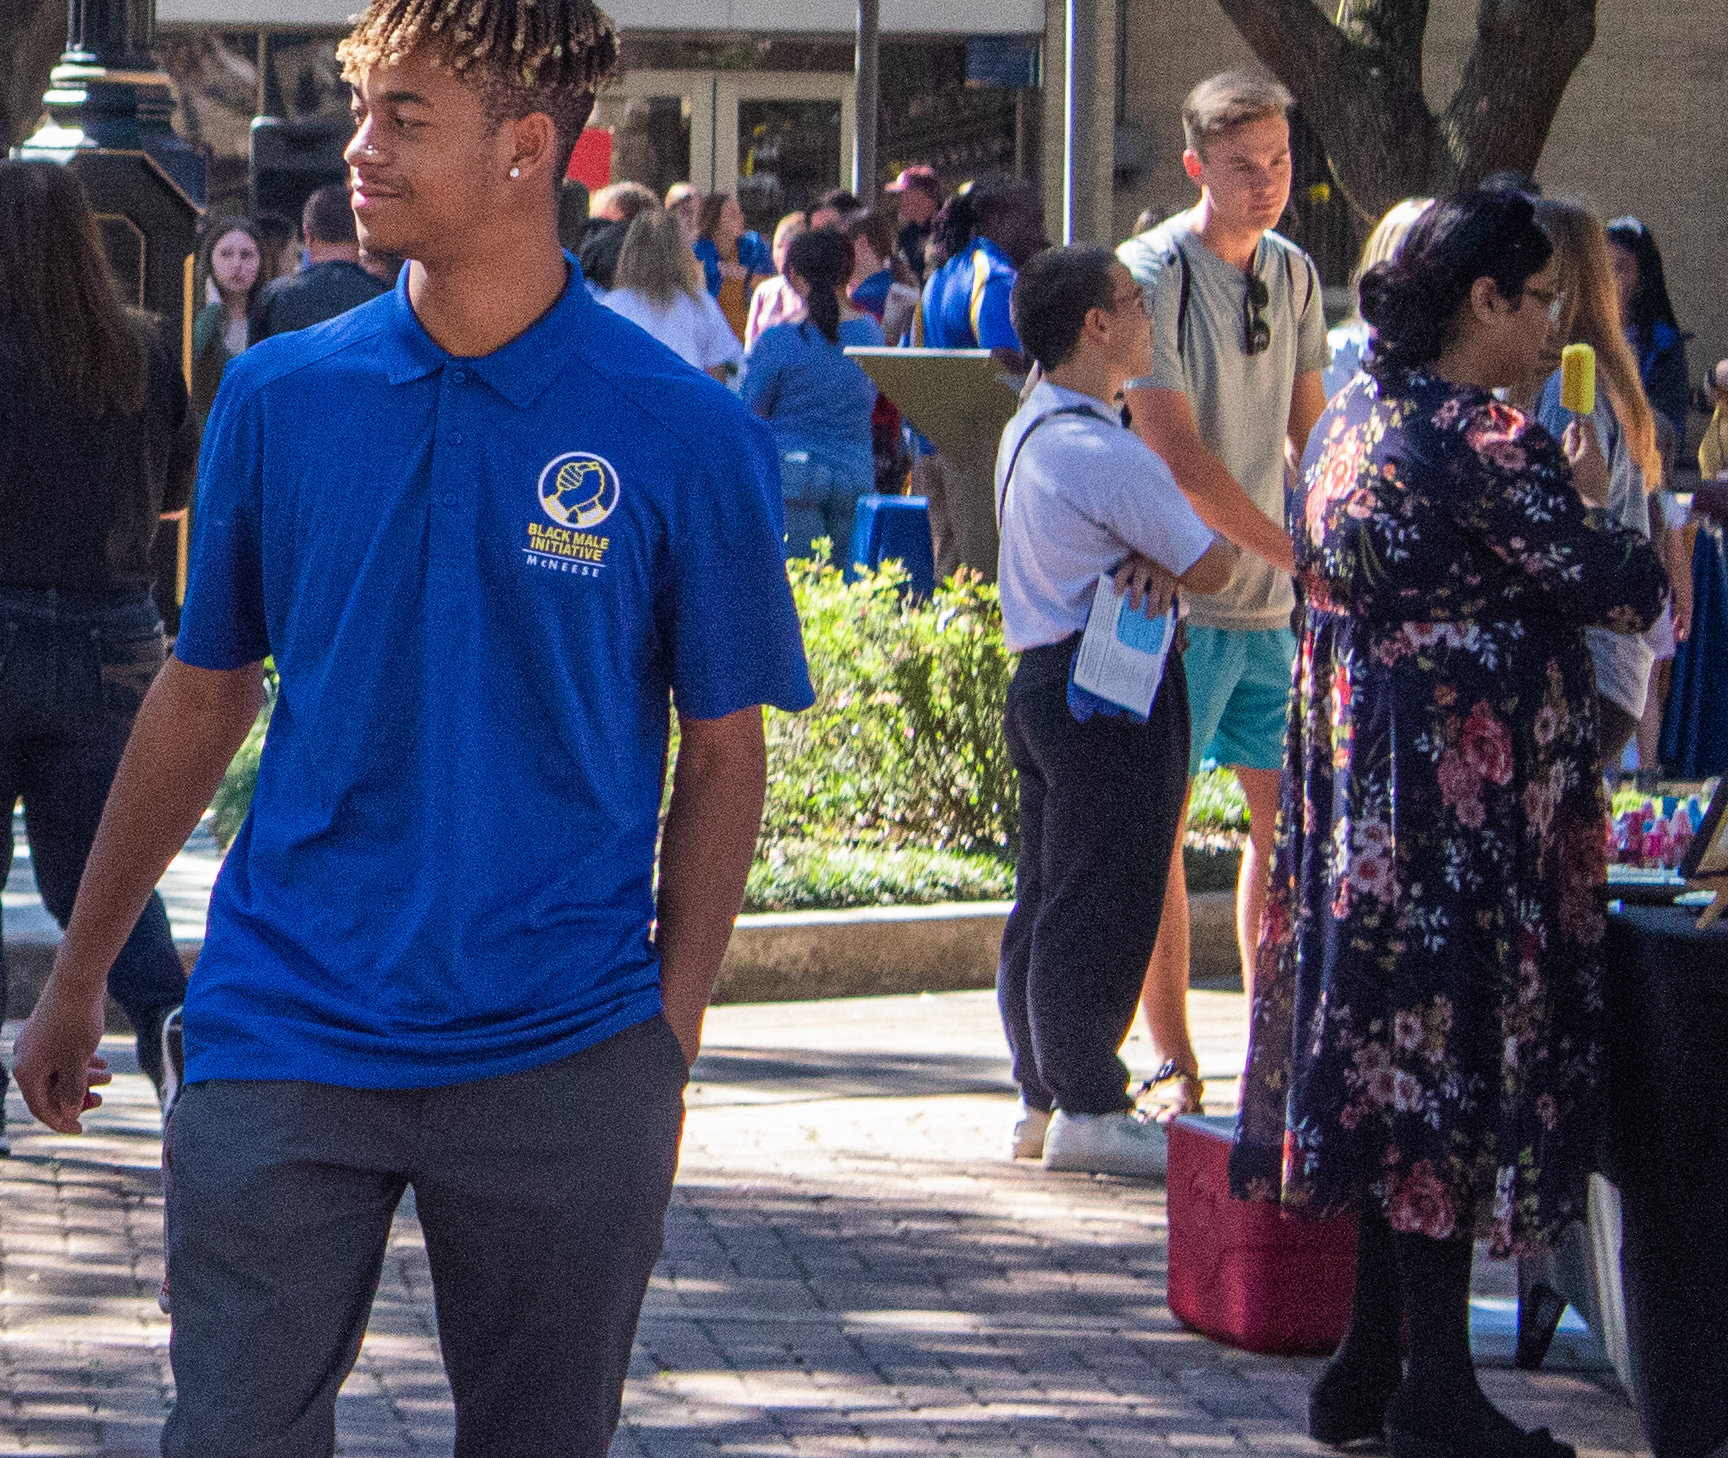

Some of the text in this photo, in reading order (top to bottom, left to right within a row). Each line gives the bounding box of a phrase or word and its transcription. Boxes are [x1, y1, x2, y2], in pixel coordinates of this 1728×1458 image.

[528, 523, 609, 549] BLACK MALE
[531, 537, 602, 561] INITIATIVE
